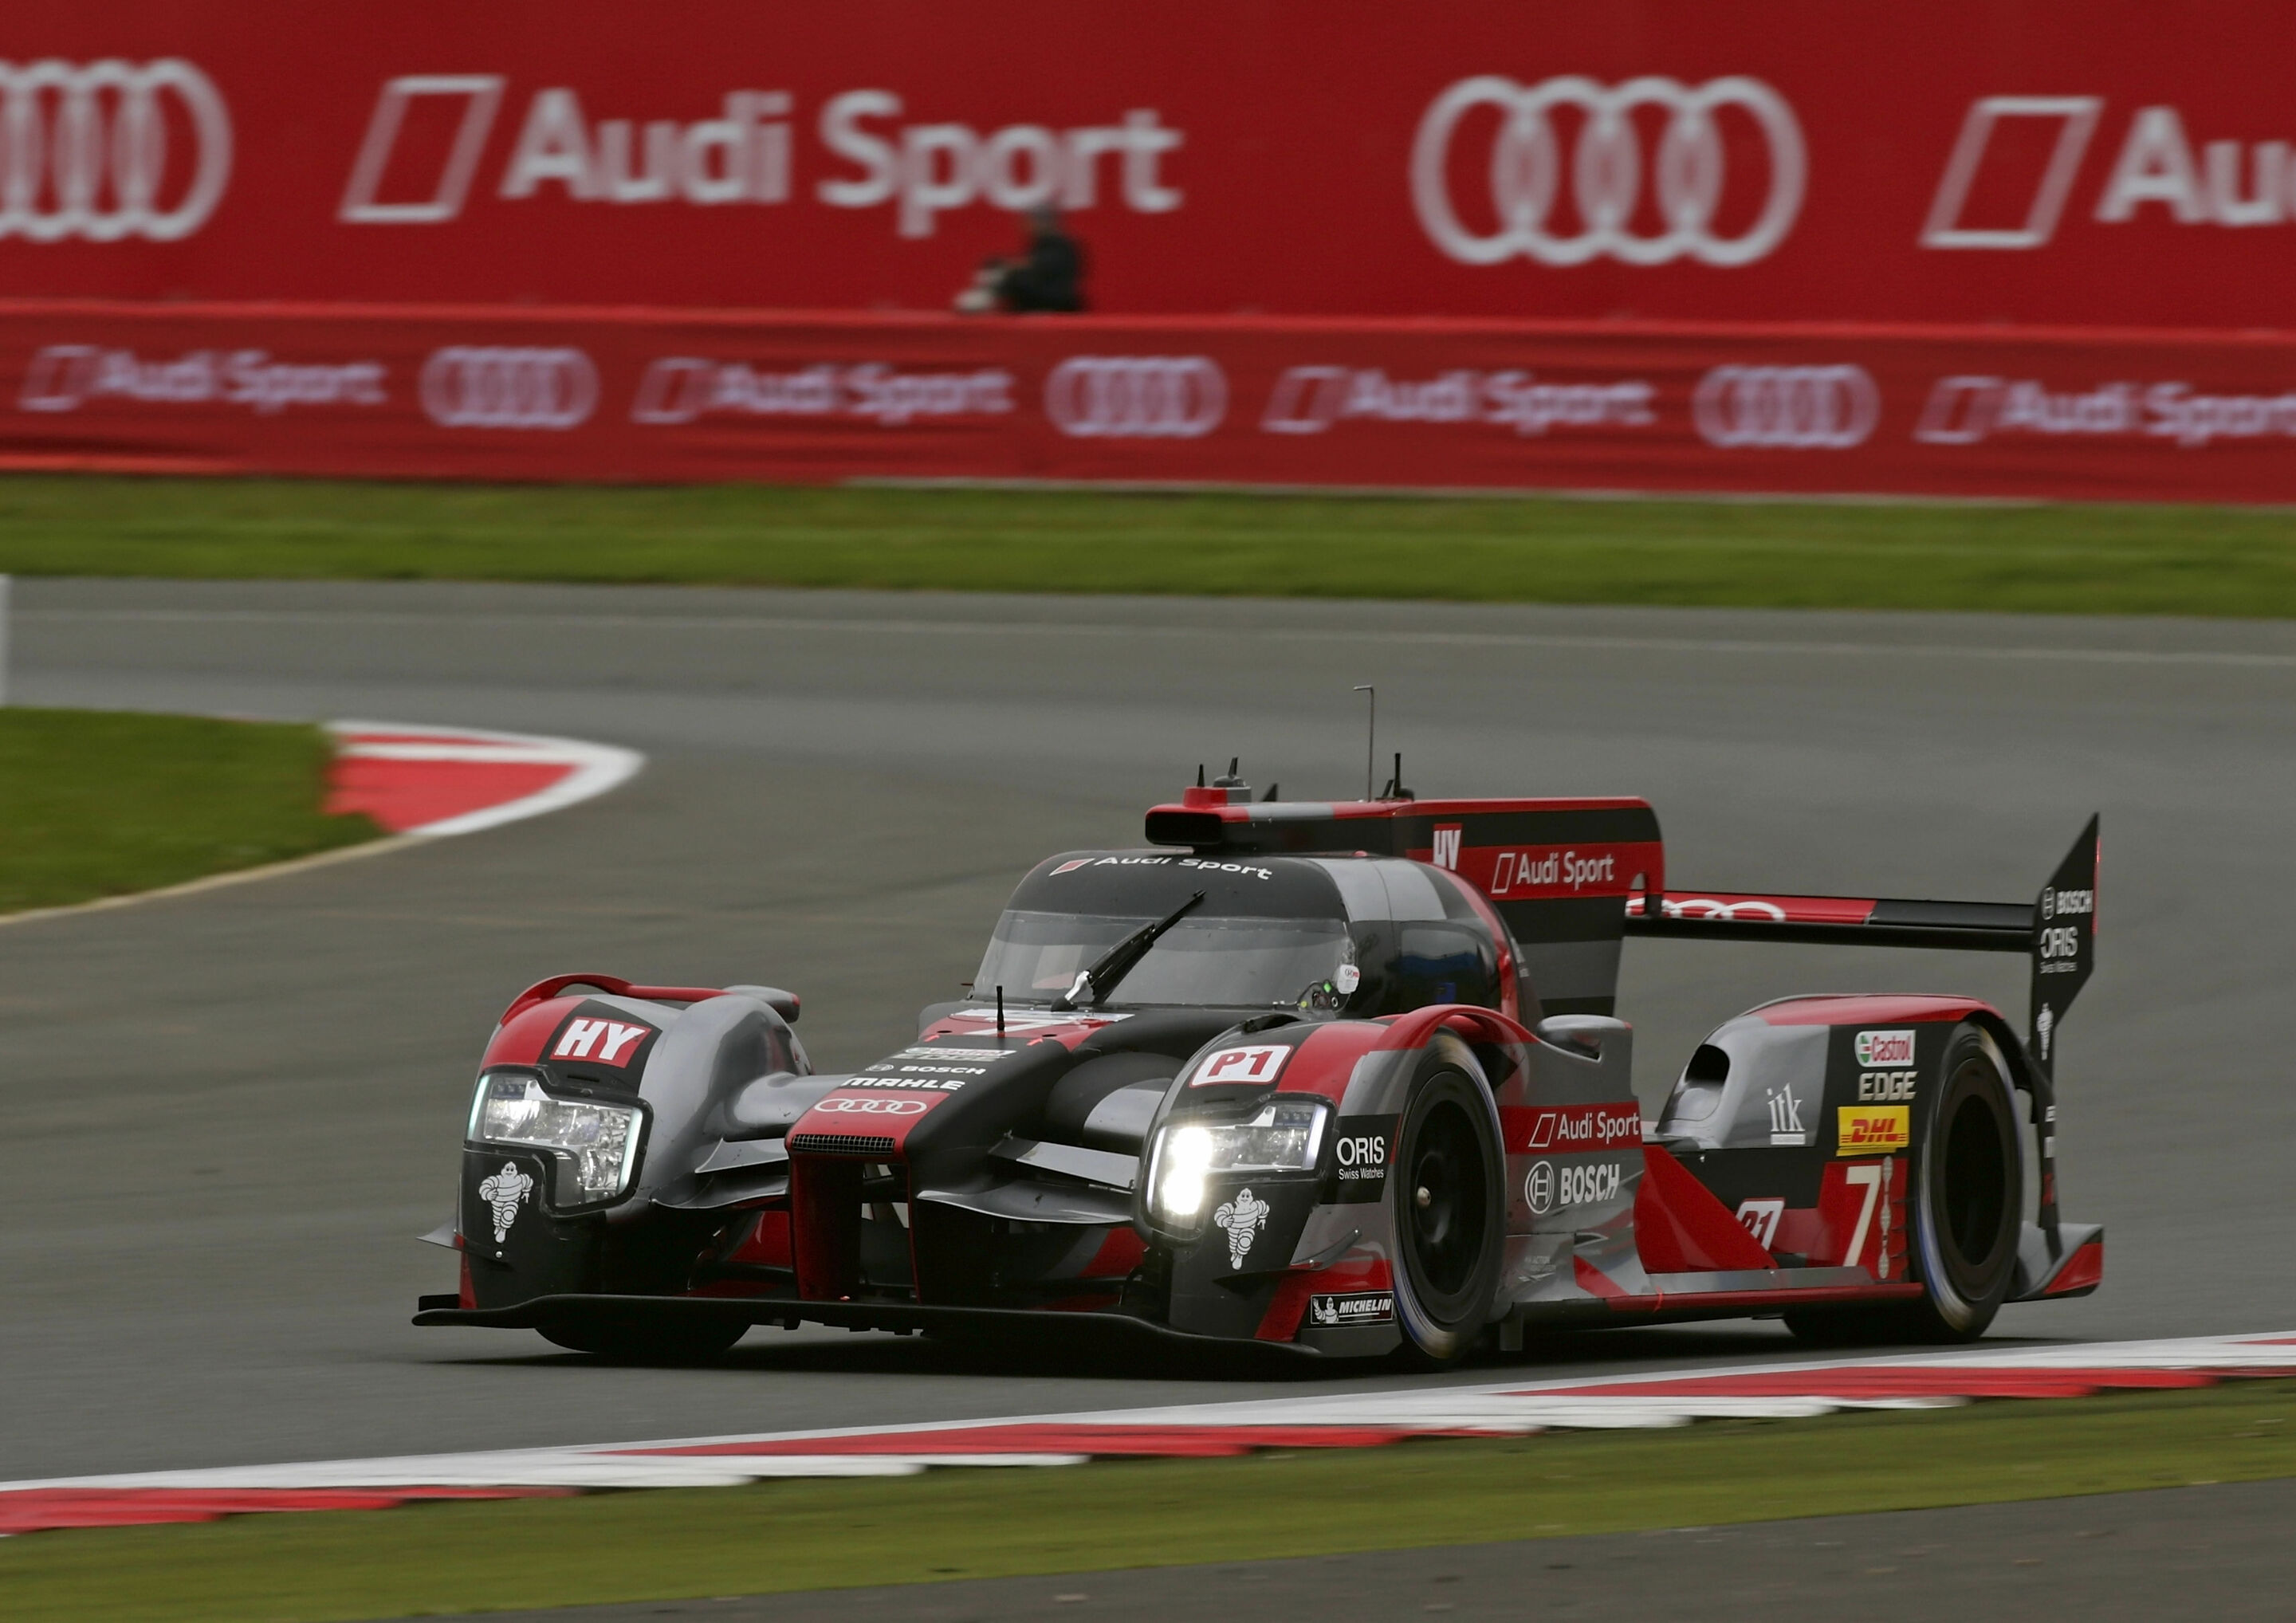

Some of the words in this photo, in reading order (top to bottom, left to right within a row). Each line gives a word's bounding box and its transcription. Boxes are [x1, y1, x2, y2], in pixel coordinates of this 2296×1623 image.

[499, 88, 792, 204] Audi
[816, 88, 1185, 238] Sport
[2092, 105, 2296, 228] Au
[91, 349, 218, 400] Audi
[227, 349, 388, 415] Sport
[711, 362, 840, 413] Audi
[847, 362, 1014, 426] Sport
[1343, 368, 1480, 422] Audi
[1485, 370, 1657, 437] Sport
[1996, 379, 2140, 434] Audi
[1093, 856, 1172, 866] Audi
[1178, 858, 1273, 880] Sport
[1516, 852, 1559, 885] Audi
[1563, 851, 1614, 891] Sport
[2040, 926, 2078, 958] ORIS
[554, 1019, 645, 1061] HY
[1872, 1035, 1911, 1062] Castrol
[899, 1065, 986, 1075] BOSCH
[1207, 1050, 1272, 1077] P1
[841, 1077, 965, 1091] MAHLE
[1858, 1071, 1918, 1101] EDGE
[1767, 1083, 1806, 1132] itk
[1557, 1113, 1593, 1140] Audi
[1596, 1111, 1640, 1145] Sport
[1851, 1118, 1897, 1143] DHL
[1336, 1136, 1385, 1165] ORIS
[1339, 1168, 1359, 1180] Swiss
[1360, 1167, 1384, 1179] Watches
[1559, 1164, 1620, 1204] BOSCH
[1846, 1165, 1882, 1267] 7
[1339, 1299, 1392, 1314] MICHELIN
